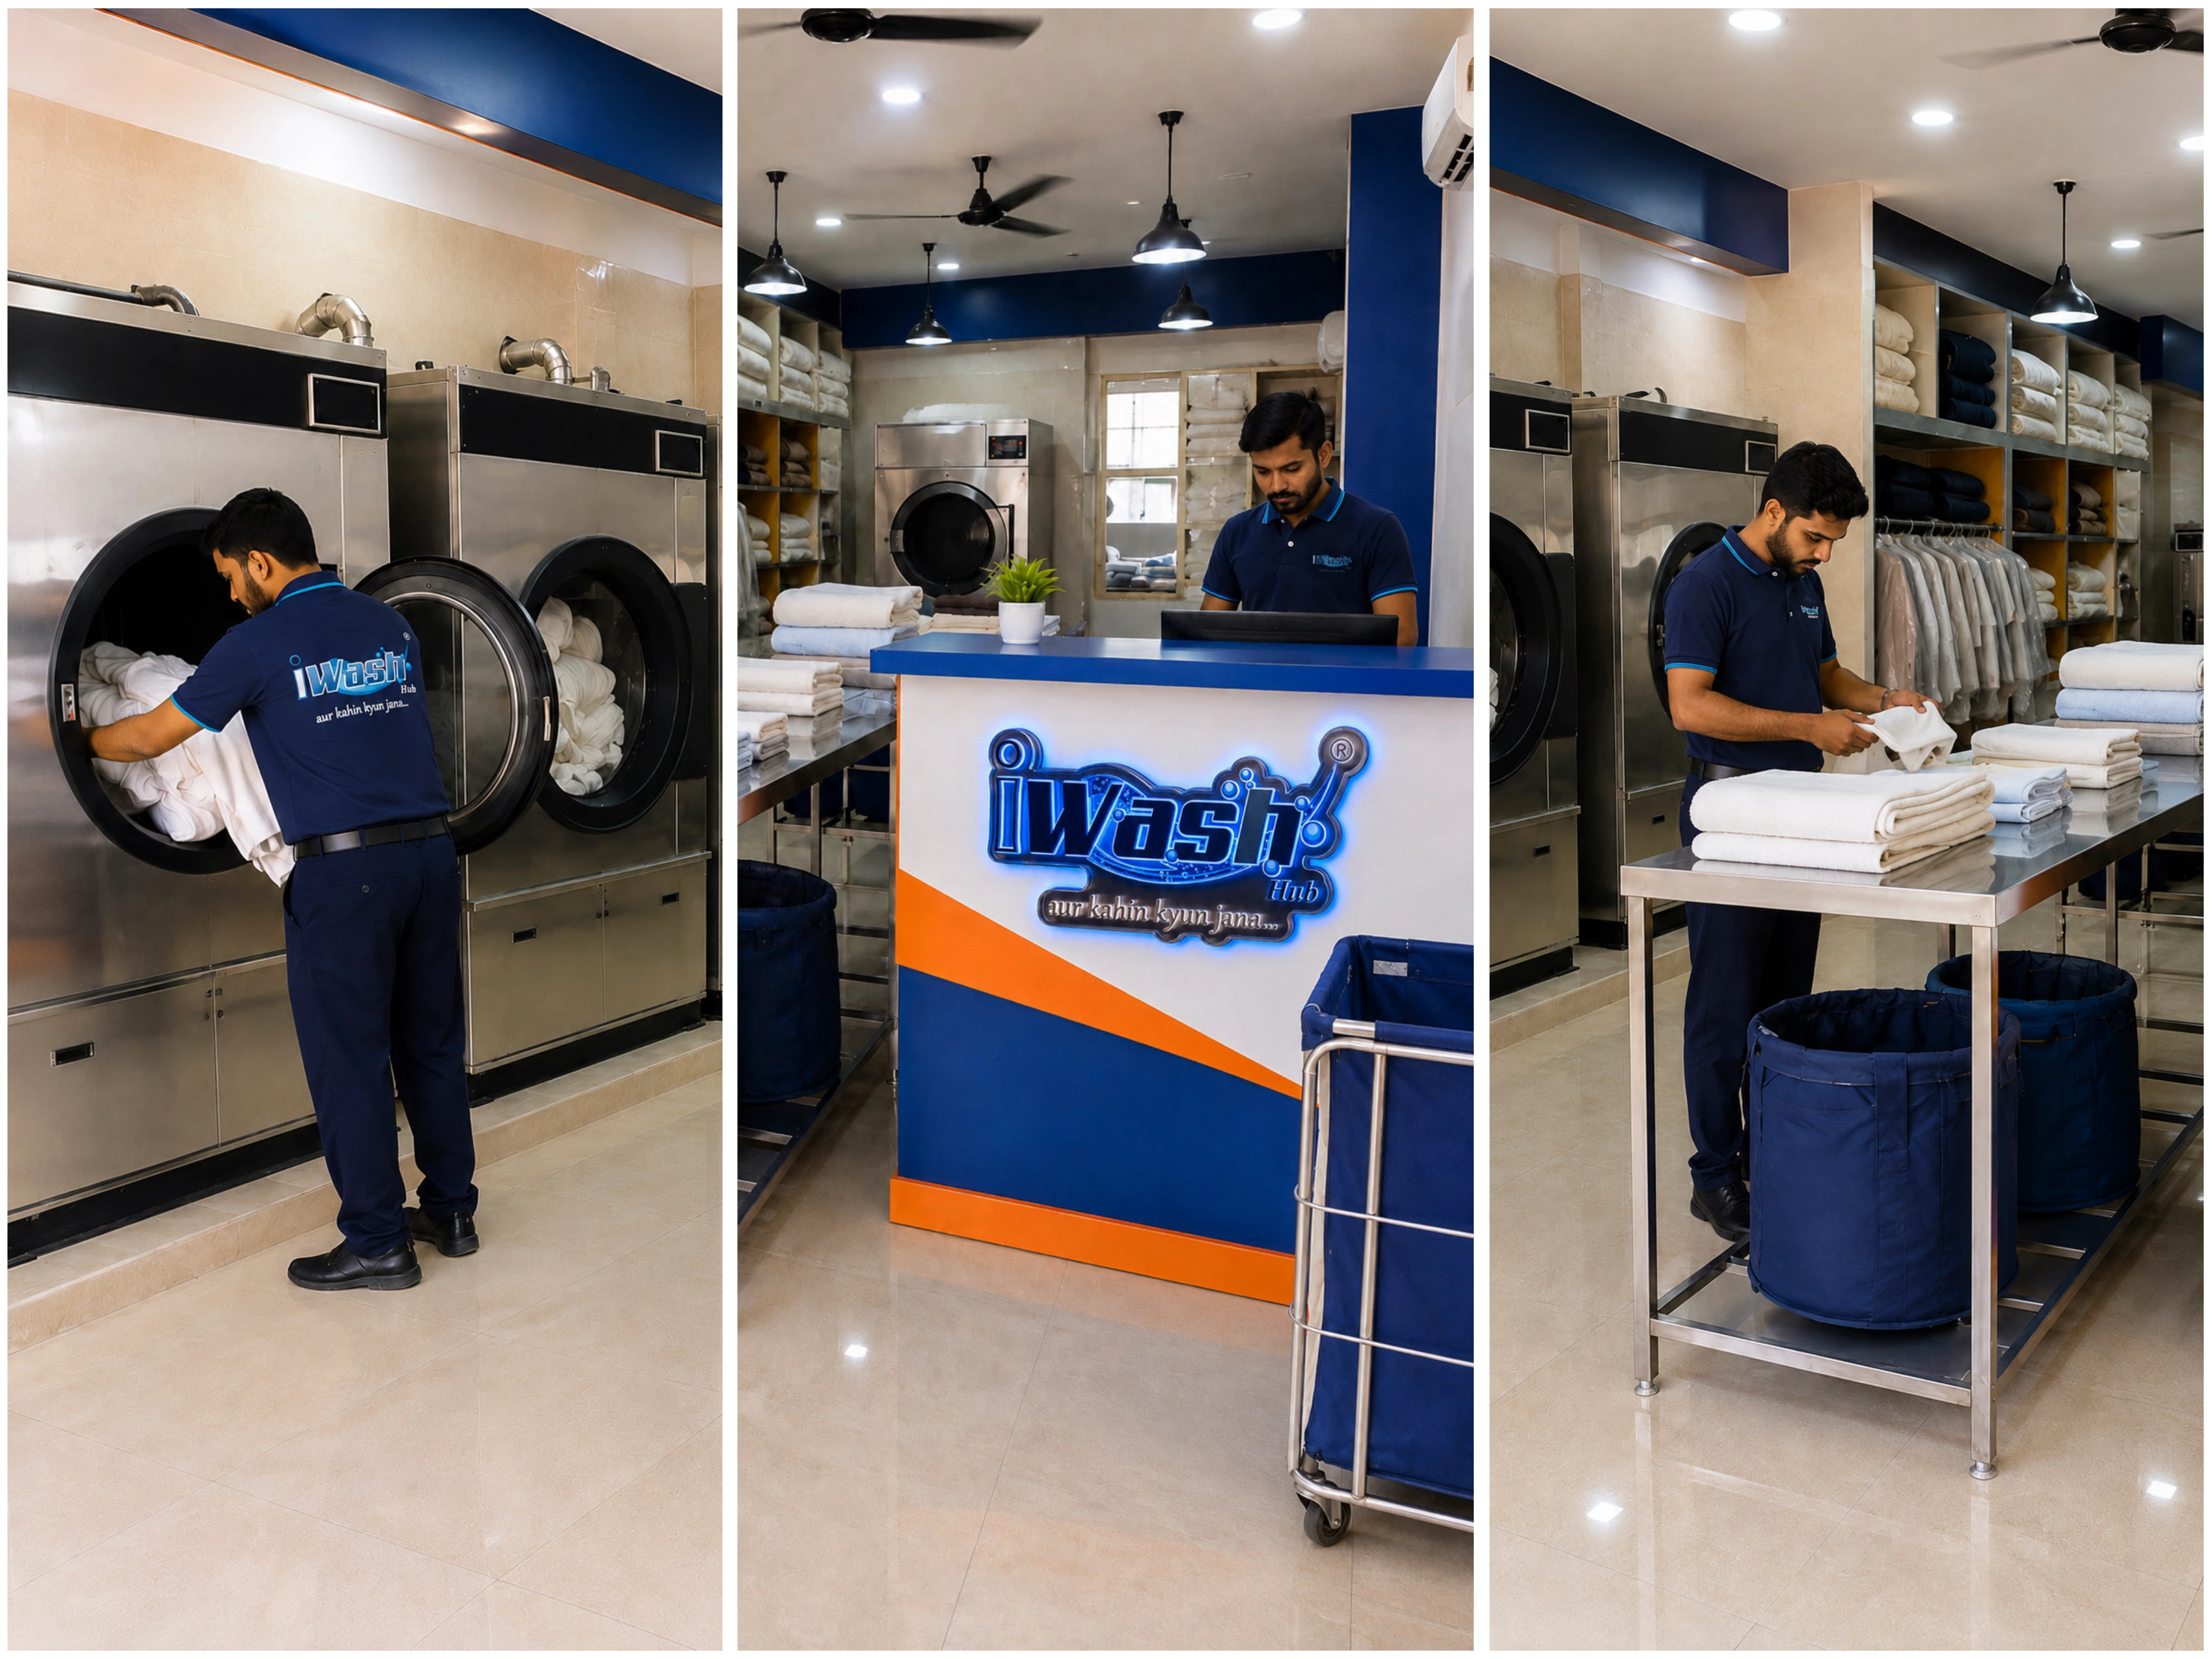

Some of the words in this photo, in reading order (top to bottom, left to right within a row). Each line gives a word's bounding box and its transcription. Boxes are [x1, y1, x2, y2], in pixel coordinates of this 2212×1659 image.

[289, 651, 407, 701] iWash
[400, 684, 416, 694] Hub
[316, 712, 334, 724] aur
[335, 705, 363, 719] kahin
[363, 701, 385, 716] kyun
[995, 737, 1306, 868] iWash
[1266, 878, 1320, 903] Hub
[1046, 898, 1083, 920] aur
[1089, 894, 1149, 922] kahin
[1156, 898, 1212, 933] kyun
[1210, 904, 1279, 936] jana...
